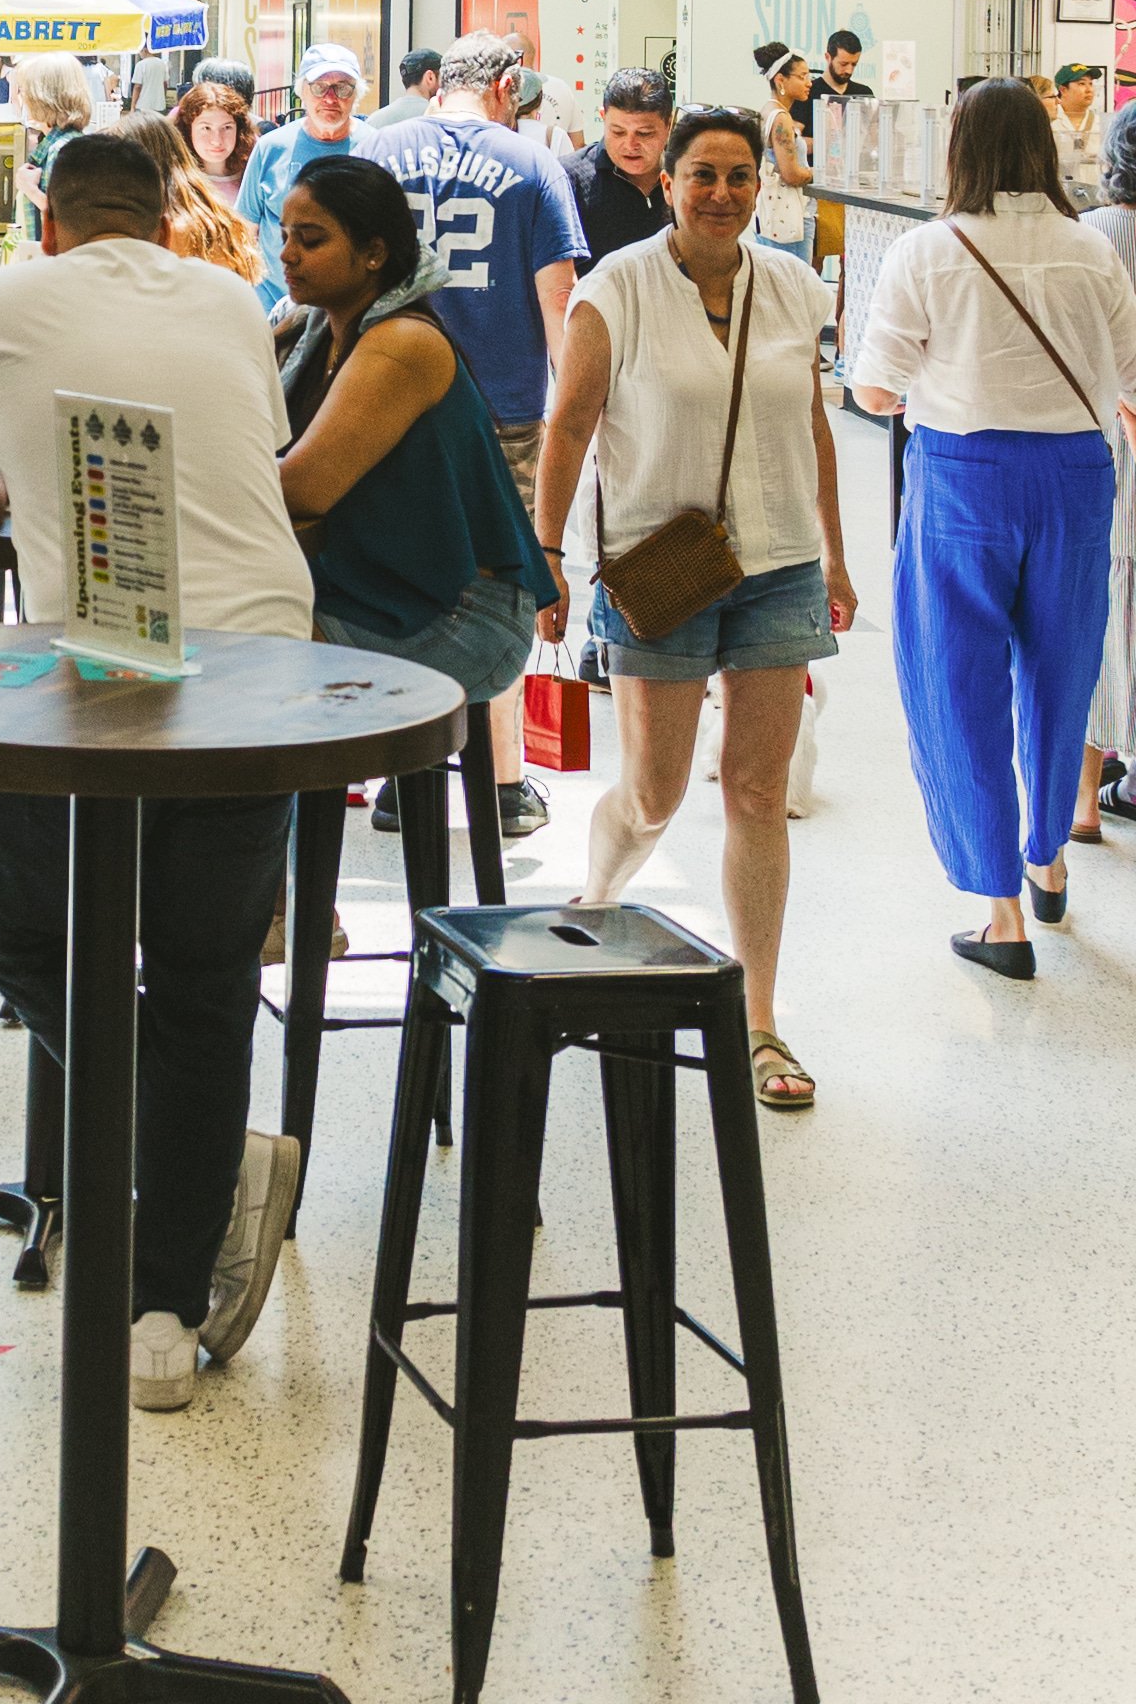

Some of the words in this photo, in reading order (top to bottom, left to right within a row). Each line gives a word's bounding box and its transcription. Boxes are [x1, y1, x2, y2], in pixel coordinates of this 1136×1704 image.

[379, 145, 524, 199] LLSBURY
[70, 415, 83, 496] Events
[71, 501, 91, 620] Upcoming
